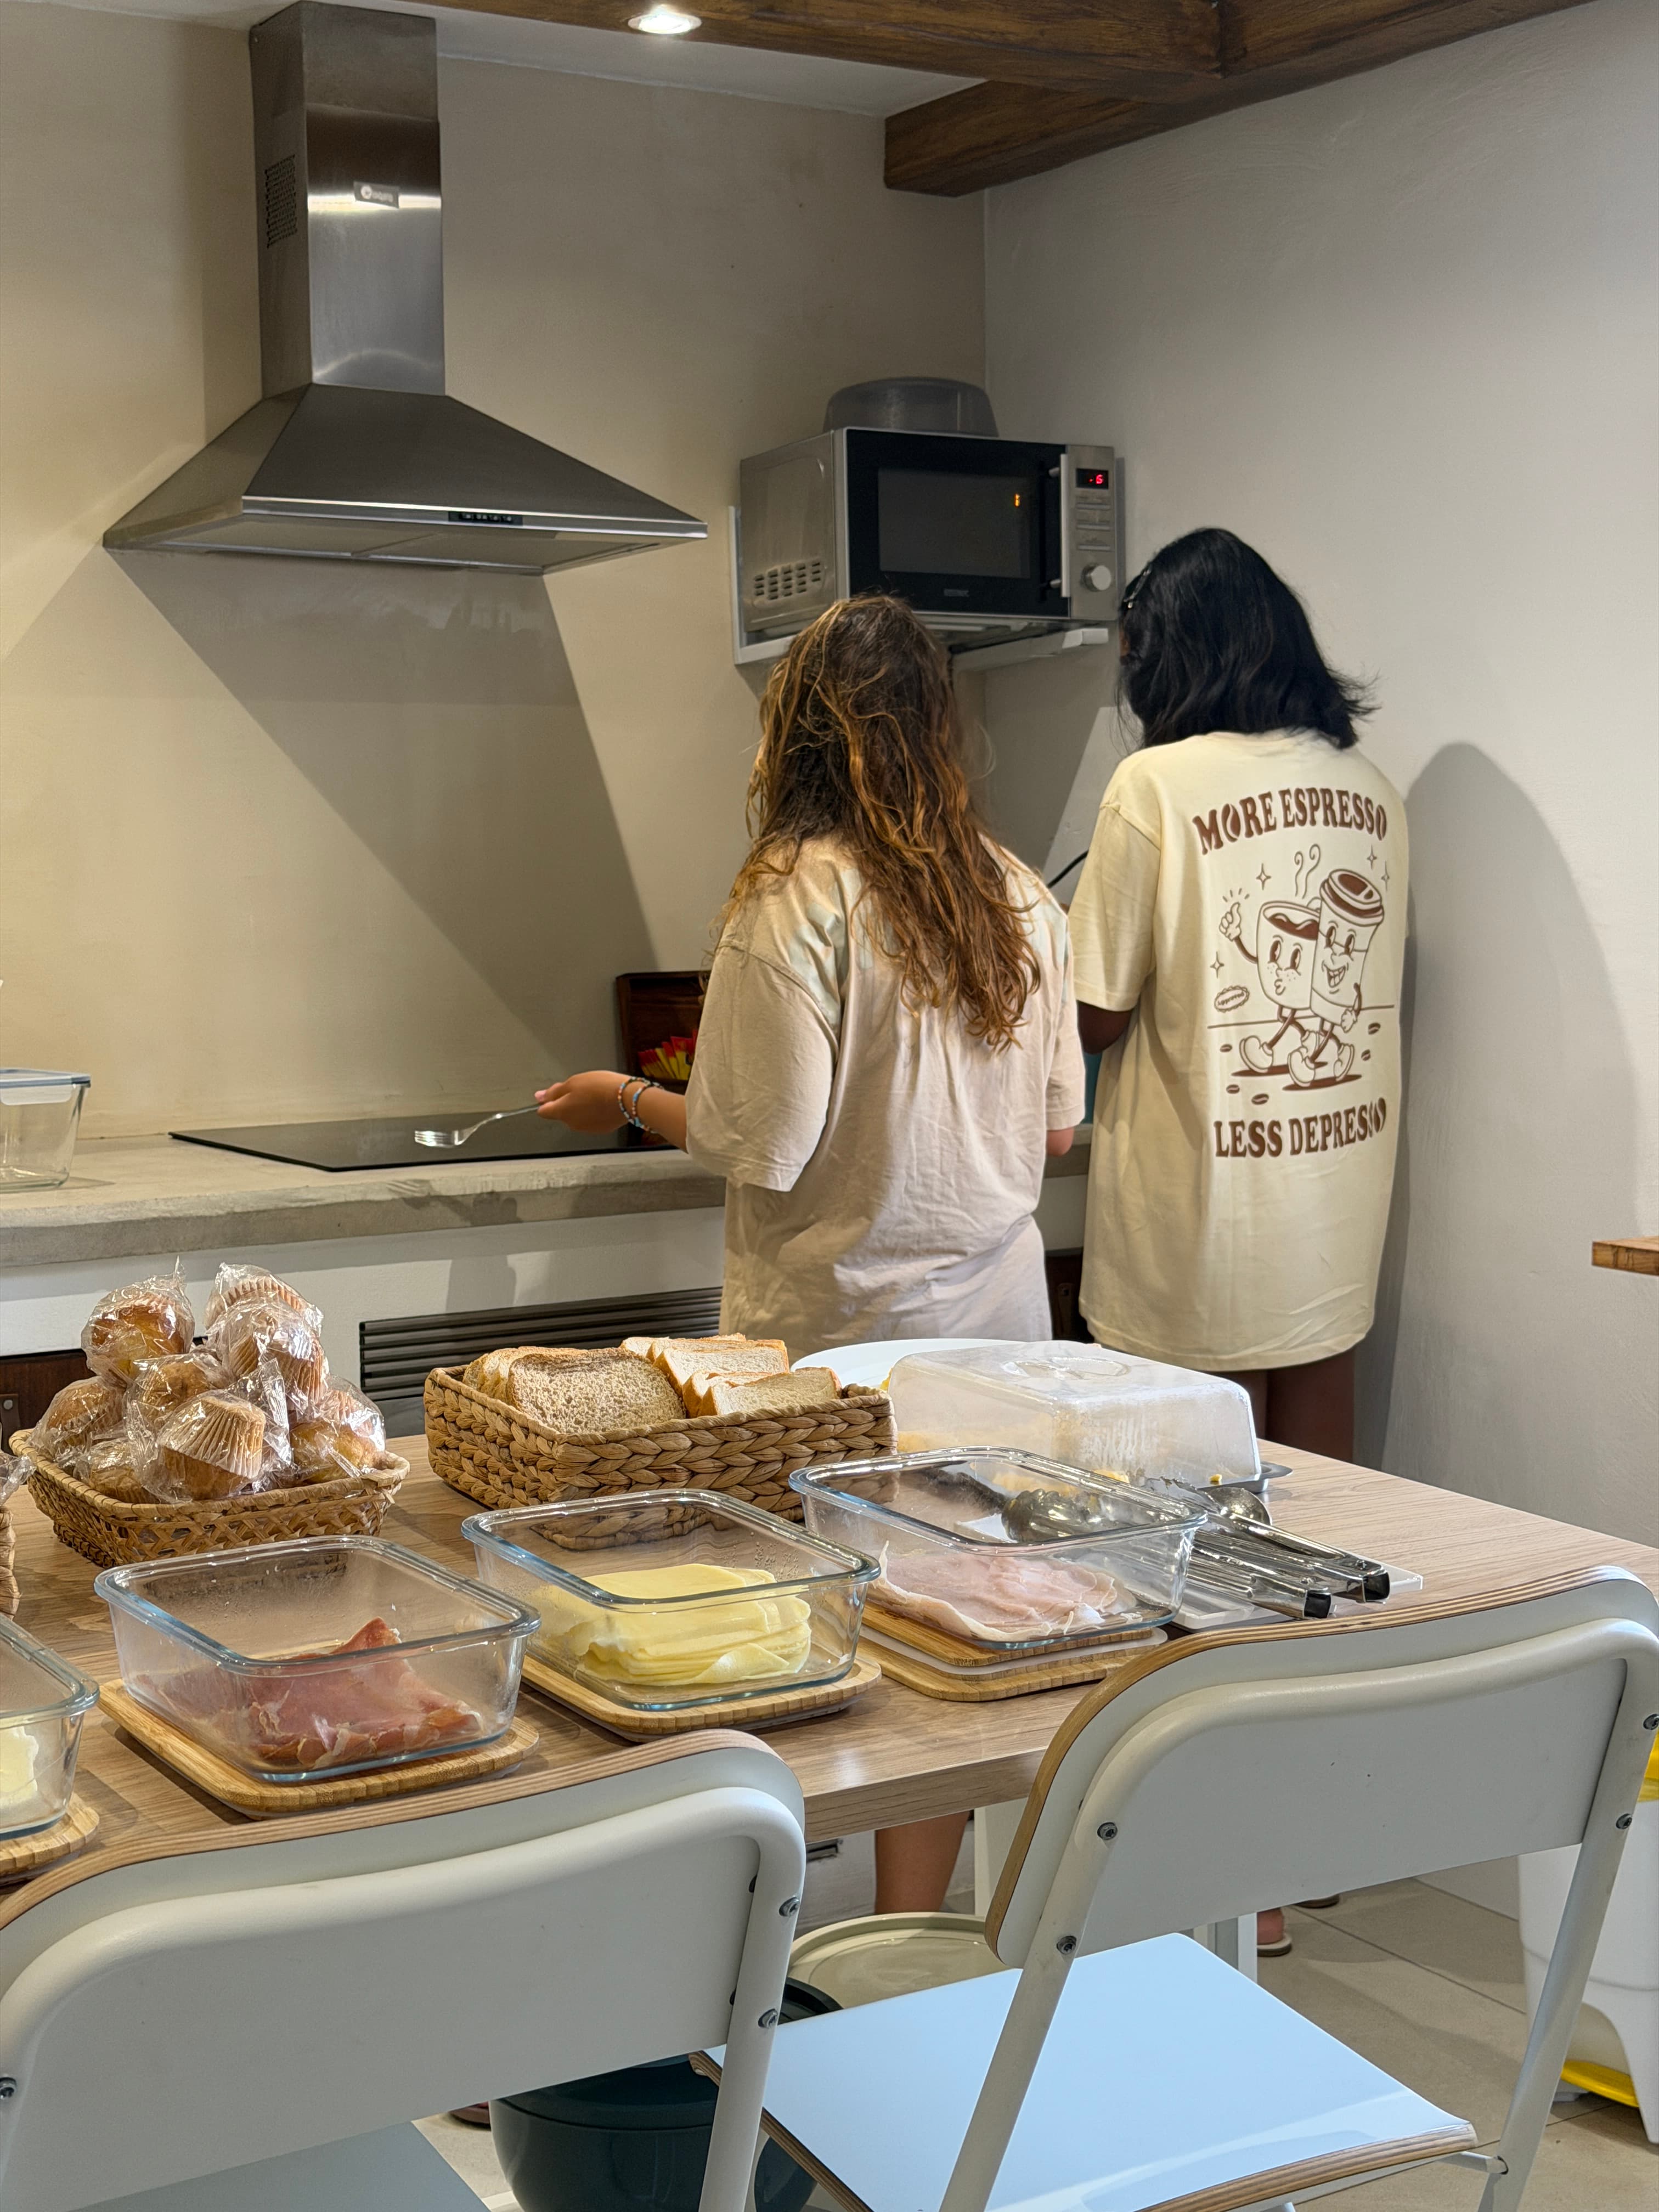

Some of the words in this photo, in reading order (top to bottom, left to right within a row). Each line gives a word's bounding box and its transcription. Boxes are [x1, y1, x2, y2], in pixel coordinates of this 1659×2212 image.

[1192, 791, 1277, 855] MORE
[1278, 787, 1387, 841] ESPRESSO
[1214, 1120, 1283, 1158] LESS
